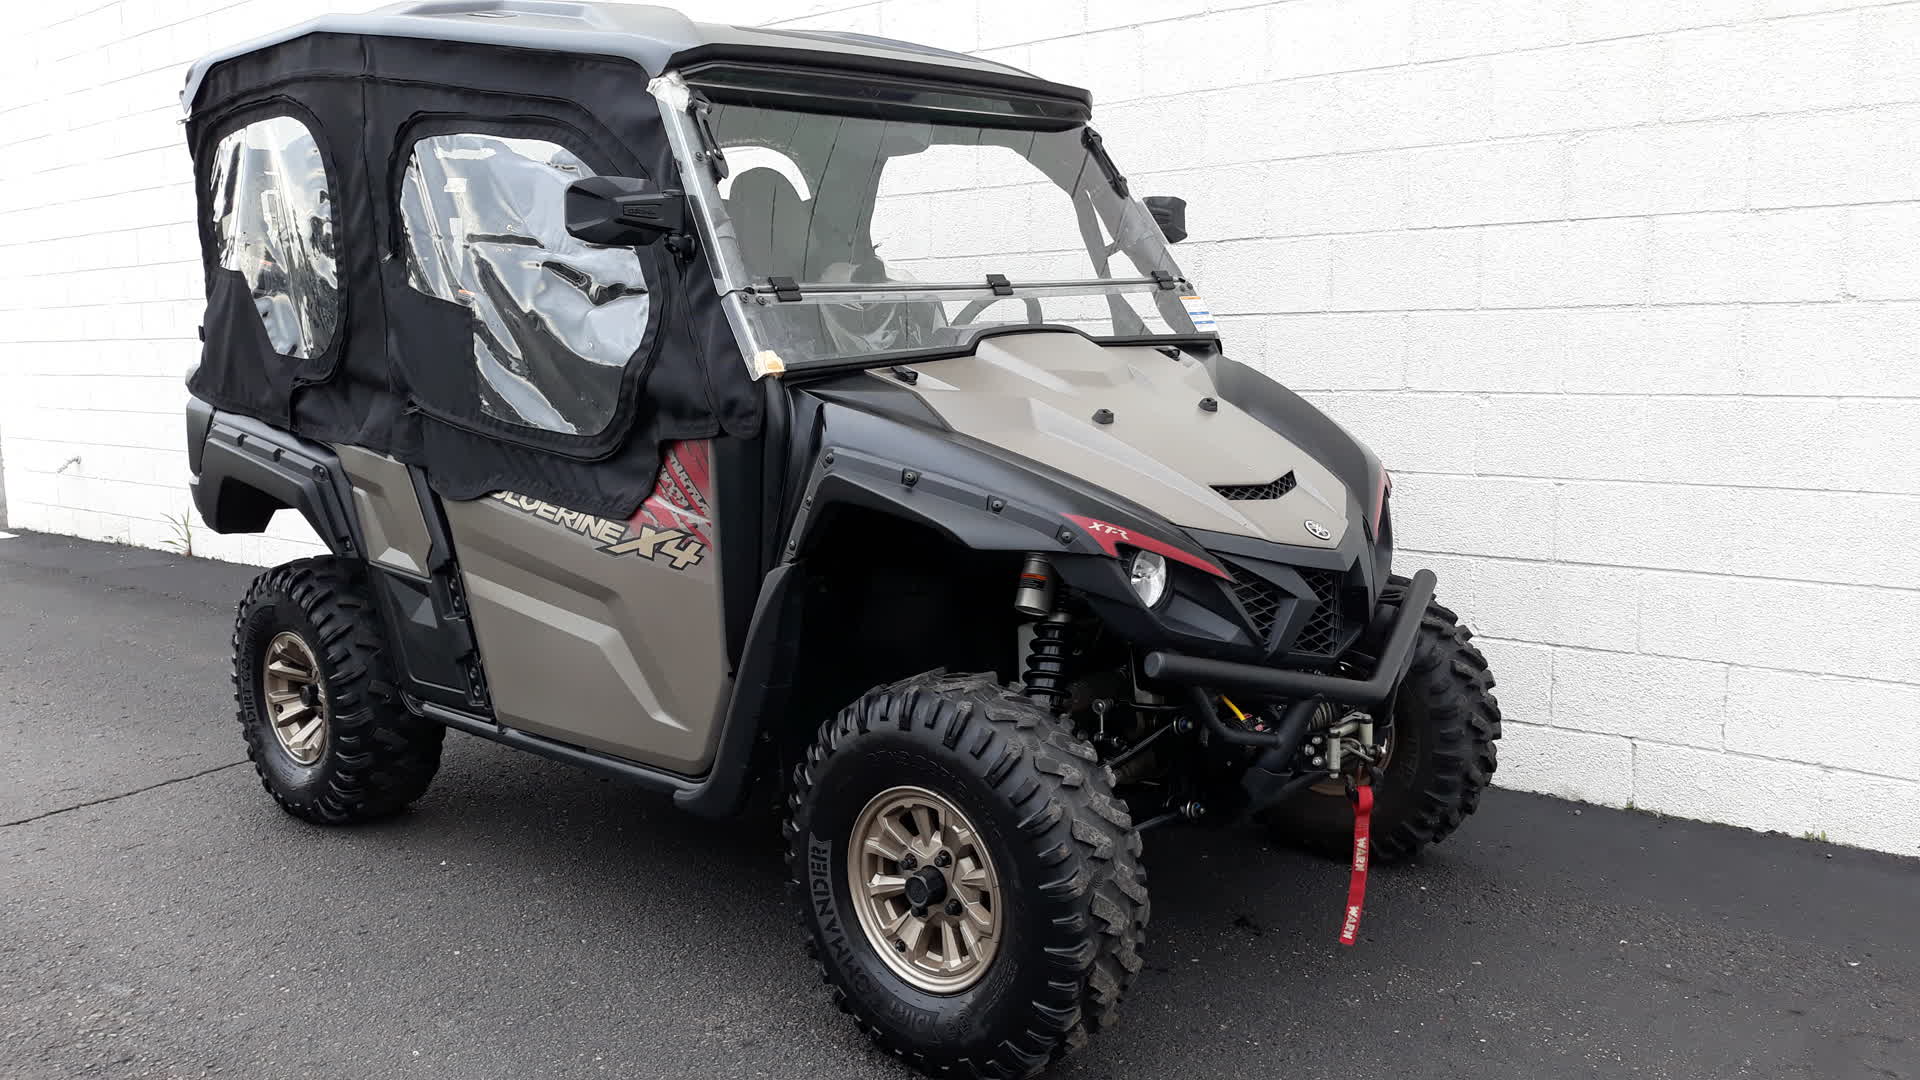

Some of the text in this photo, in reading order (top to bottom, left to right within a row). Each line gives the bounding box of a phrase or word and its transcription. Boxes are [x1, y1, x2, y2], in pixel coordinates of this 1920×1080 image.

[492, 490, 703, 570] LVERINE X4
[1355, 837, 1367, 872] WARN
[1342, 905, 1360, 940] WARN
